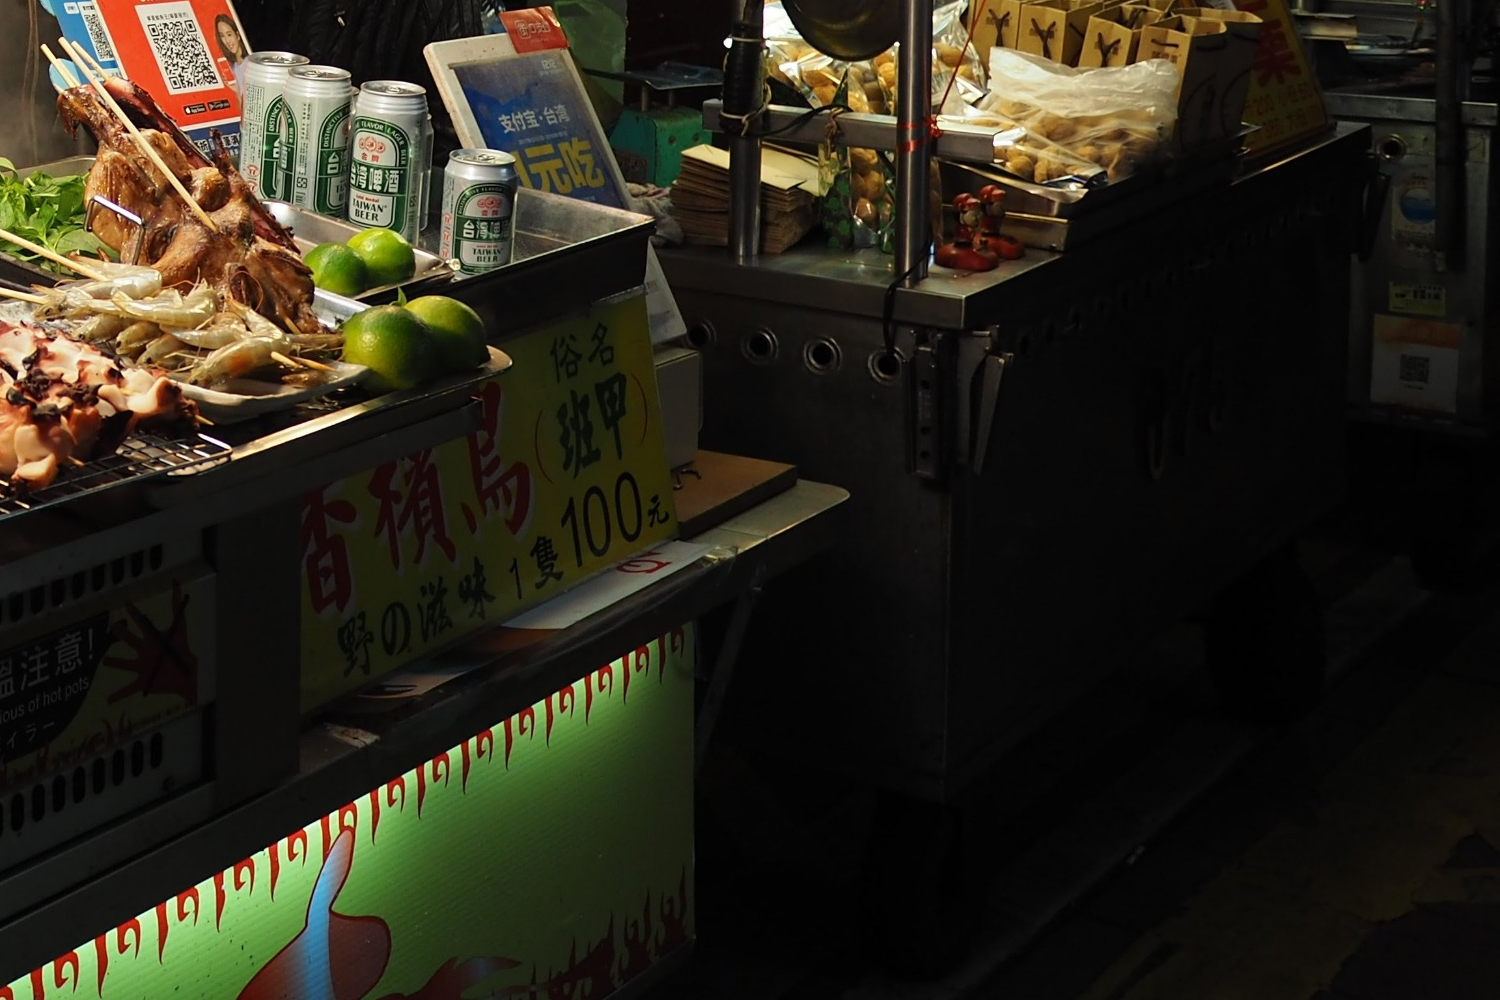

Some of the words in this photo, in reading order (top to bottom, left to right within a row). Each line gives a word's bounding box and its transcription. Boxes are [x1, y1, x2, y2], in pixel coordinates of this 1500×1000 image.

[361, 121, 385, 130] FLAVOR
[386, 127, 404, 146] LAGER
[498, 104, 570, 134] 支付宝·台湾
[350, 164, 401, 194] 台灣啤酒
[352, 199, 384, 213] TAIWAN
[354, 211, 378, 222] BEER
[472, 248, 501, 256] TAIWAN
[550, 321, 616, 383] 俗名
[534, 371, 648, 485] (班甲)
[338, 557, 495, 678] 野の滋味
[509, 471, 670, 600] 1隻100元
[28, 698, 42, 714] of
[43, 689, 63, 708] hot
[64, 676, 90, 703] pots
